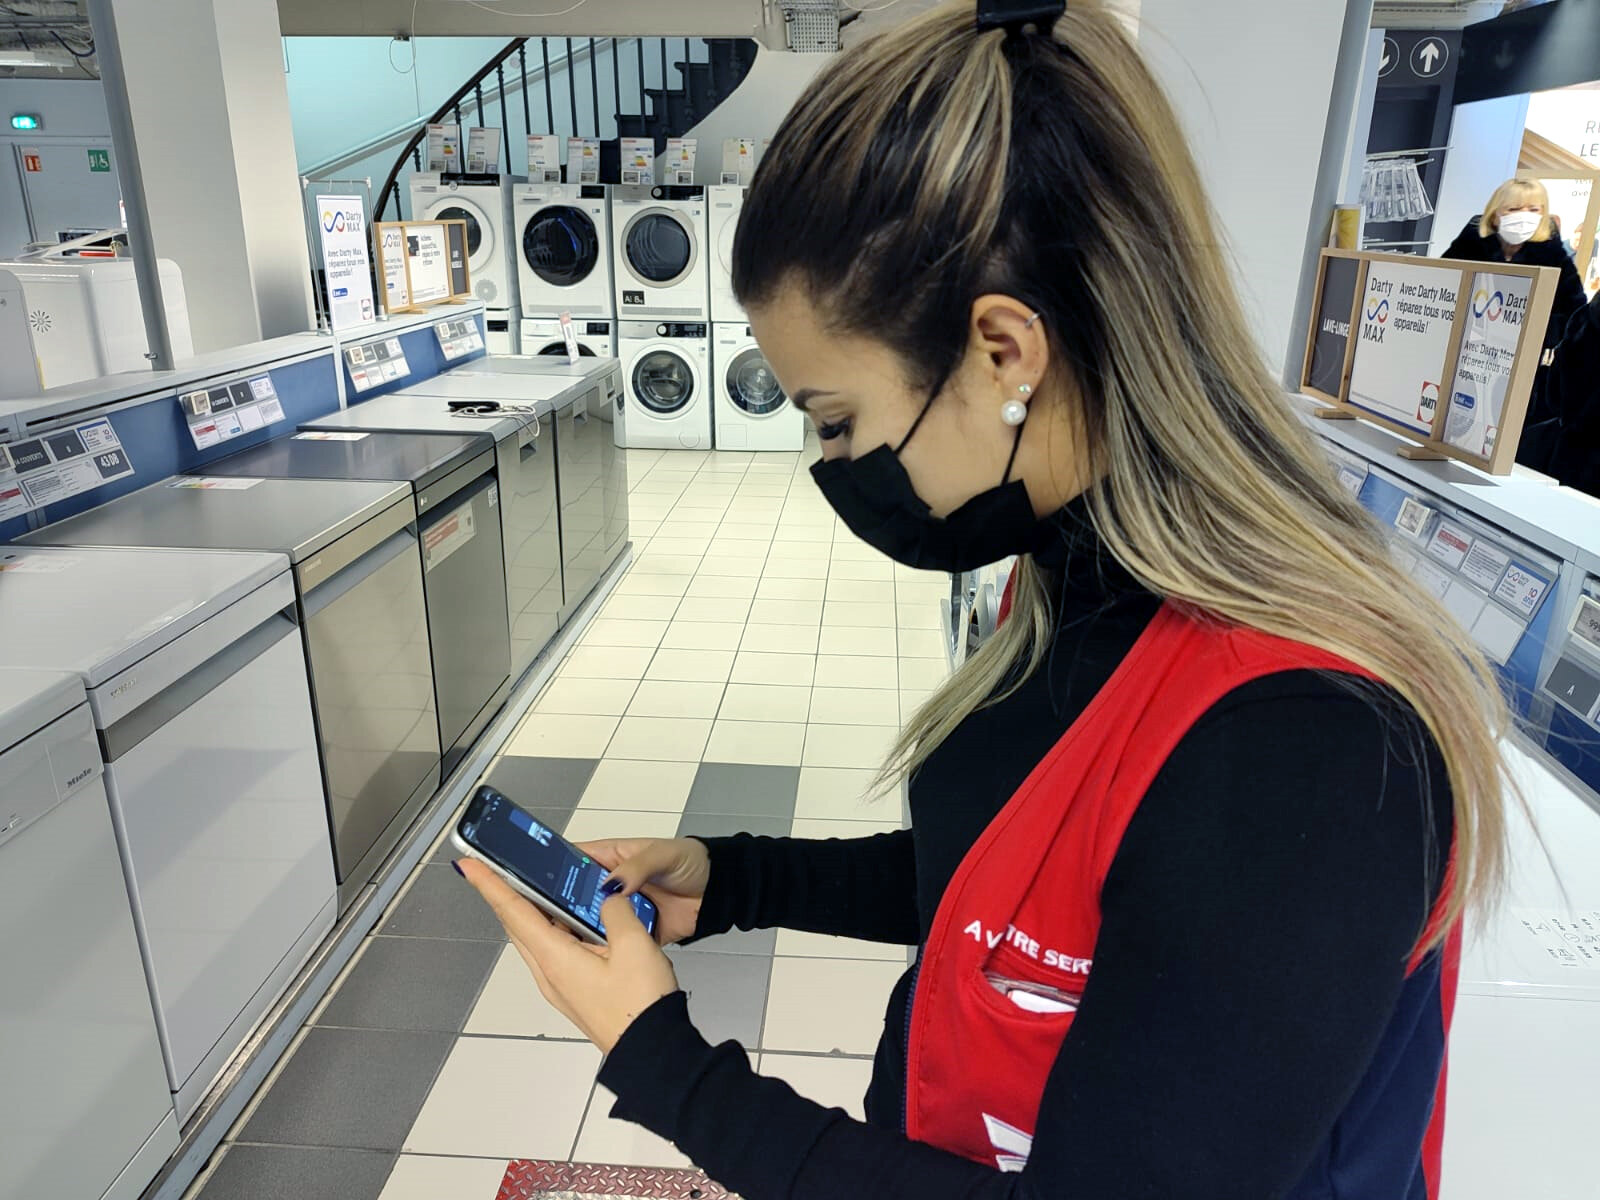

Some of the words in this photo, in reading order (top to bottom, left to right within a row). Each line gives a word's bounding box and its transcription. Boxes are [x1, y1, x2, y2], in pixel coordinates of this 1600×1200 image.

[1371, 277, 1394, 297] Darty
[1400, 282, 1417, 297] Avec
[1417, 284, 1439, 303] Darty
[1438, 287, 1457, 305] Max,
[1396, 299, 1423, 315] réparez
[1423, 303, 1440, 319] tous
[1441, 308, 1456, 322] vos
[1323, 317, 1351, 338] LAVE-LINGE
[1363, 323, 1386, 344] MAX
[1463, 339, 1480, 353] Avec
[1480, 343, 1499, 360] Darty
[1460, 353, 1485, 368] réparez
[1566, 685, 1575, 697] A
[66, 767, 92, 788] Miele
[964, 919, 982, 942] A
